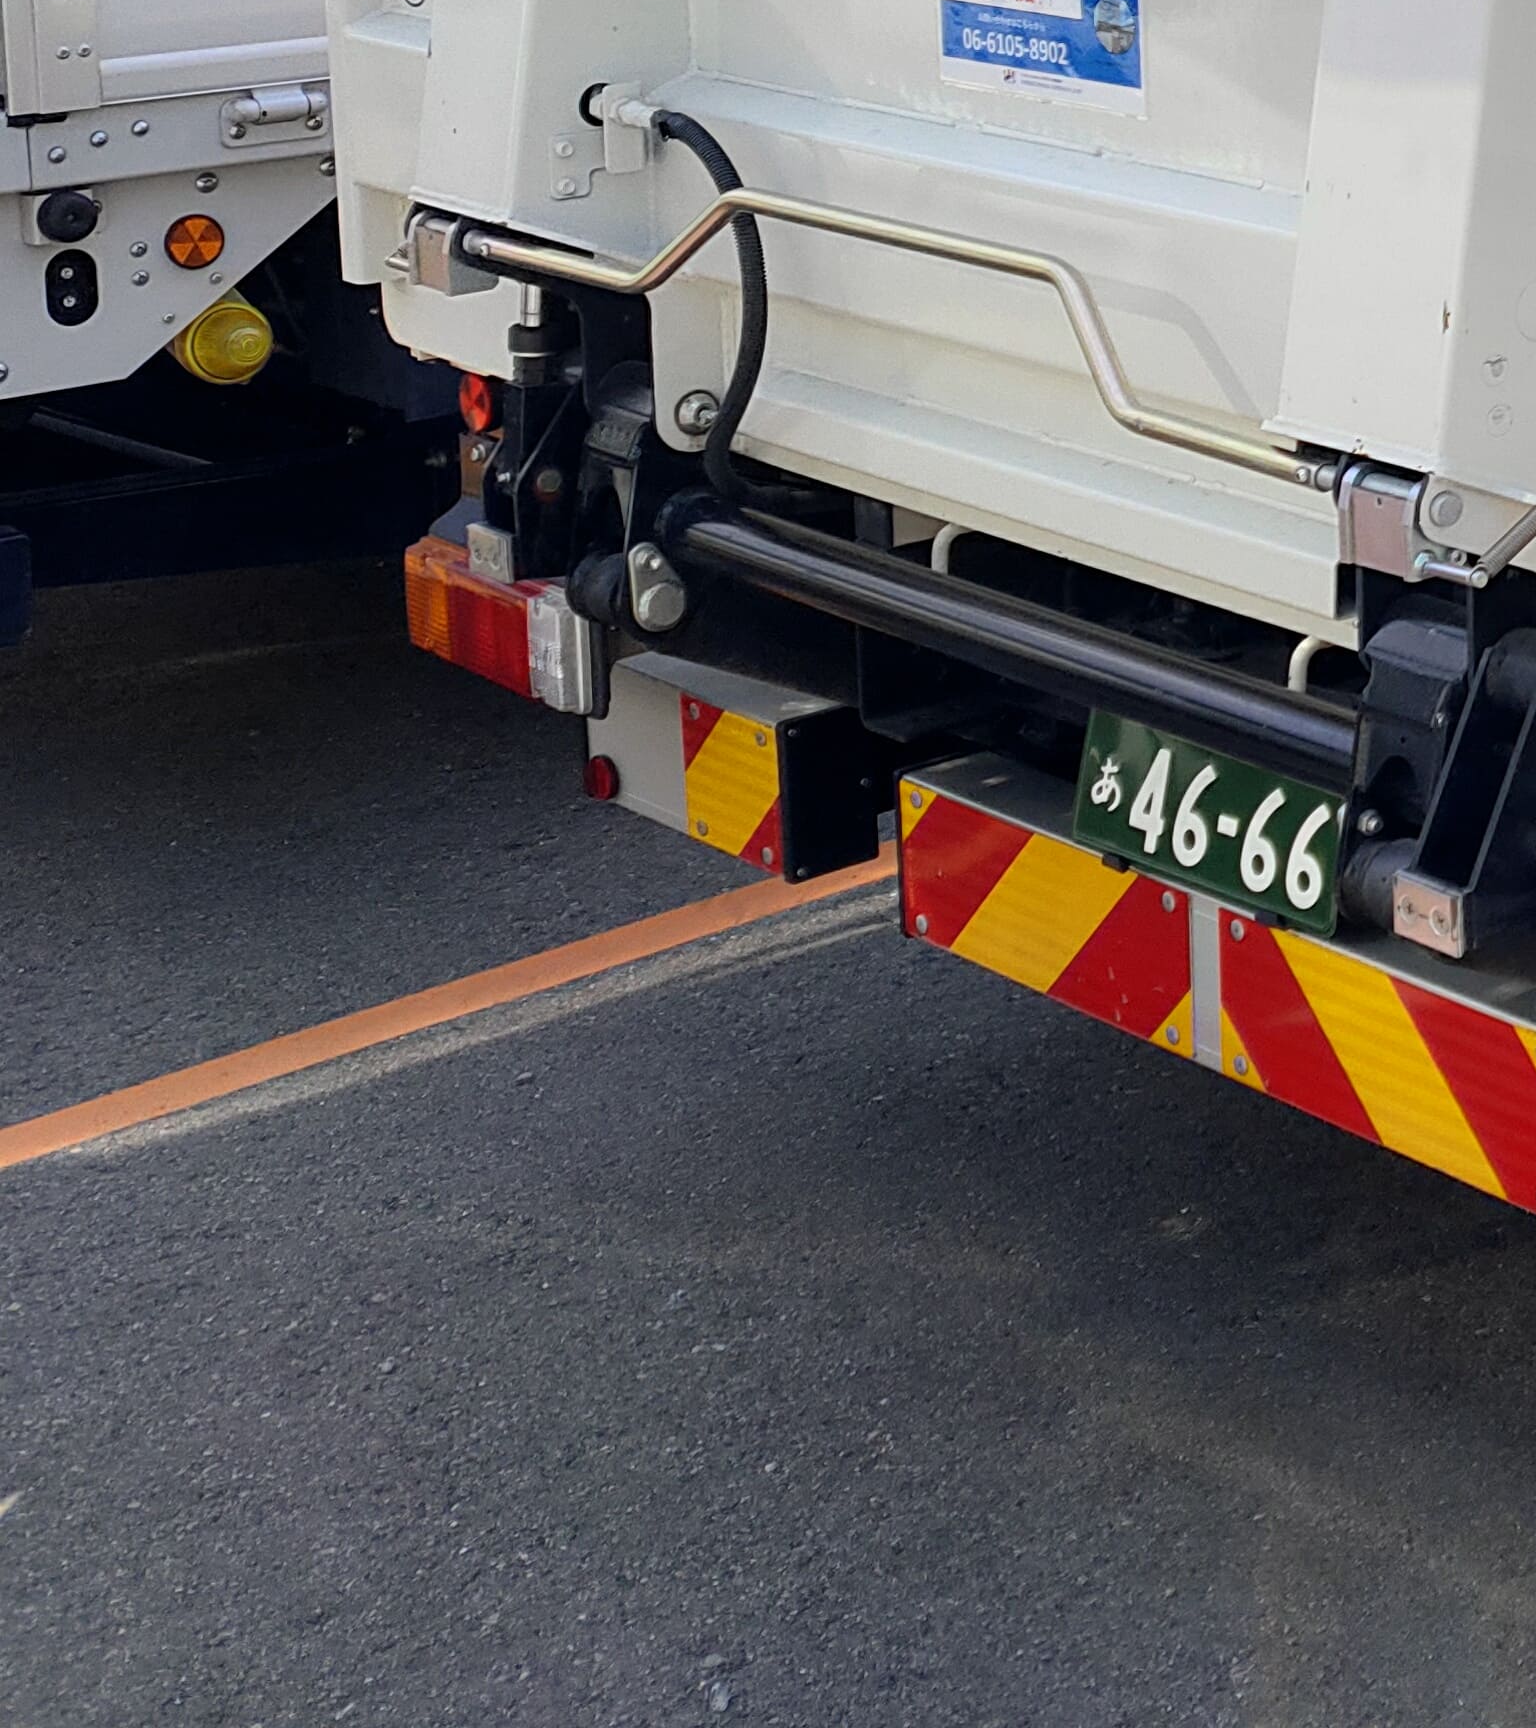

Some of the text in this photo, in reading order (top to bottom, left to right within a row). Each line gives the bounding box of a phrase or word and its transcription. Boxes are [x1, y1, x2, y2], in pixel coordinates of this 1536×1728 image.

[962, 27, 1069, 66] 06-6105-8902
[1091, 747, 1332, 910] あ 46-66
